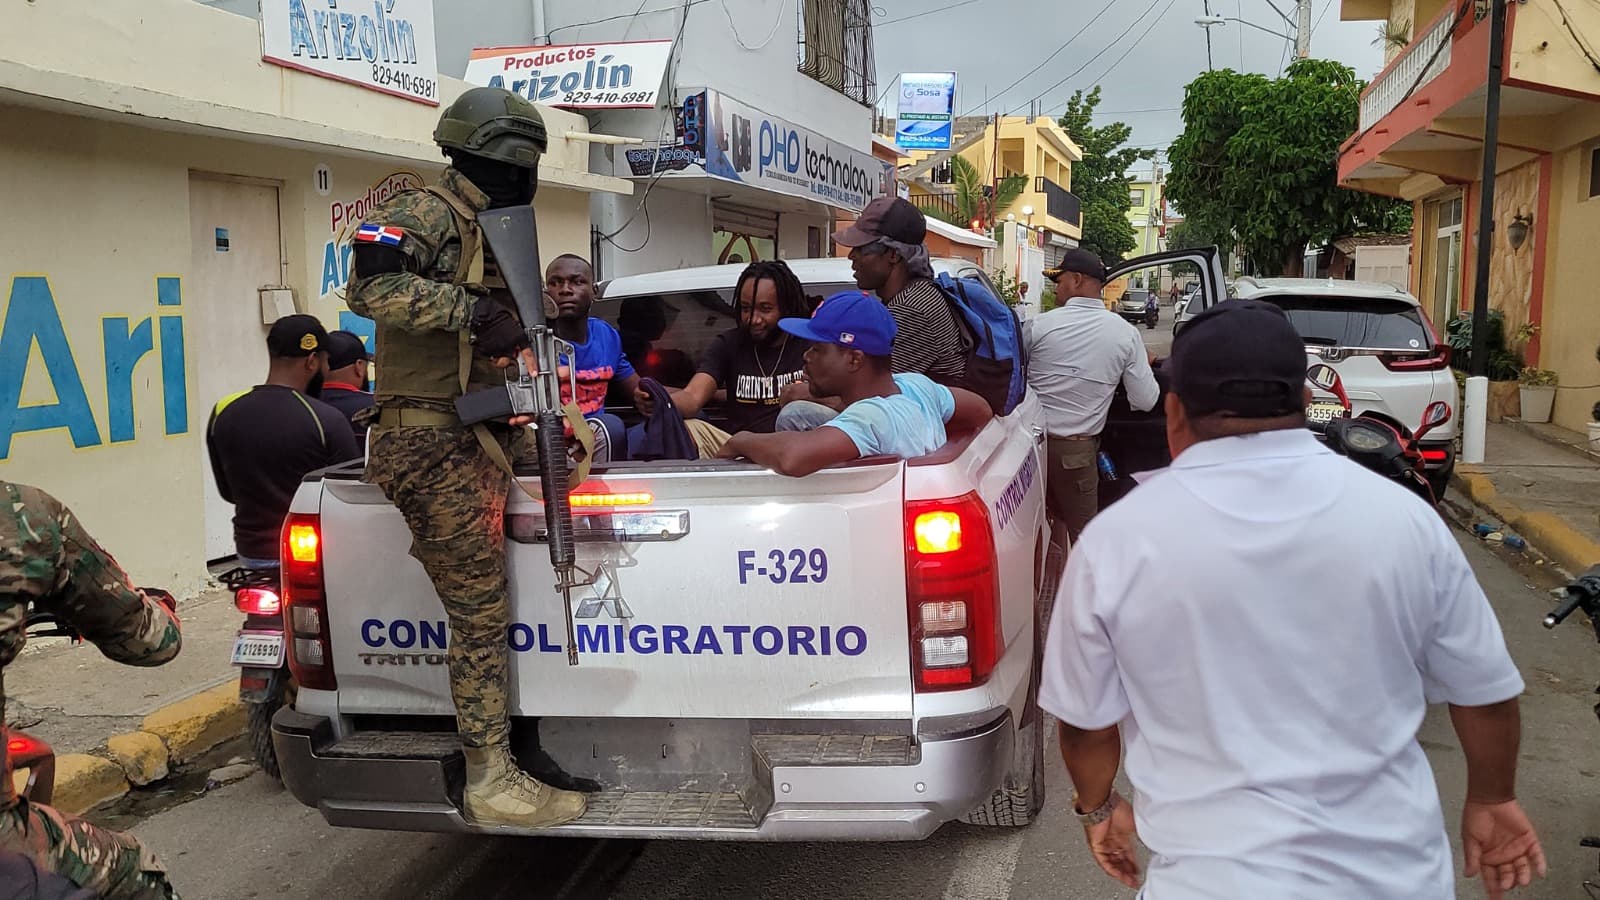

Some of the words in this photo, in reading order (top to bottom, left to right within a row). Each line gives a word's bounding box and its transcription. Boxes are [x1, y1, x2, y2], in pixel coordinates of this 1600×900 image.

[289, 0, 417, 64] Arizolín
[504, 47, 596, 71] Productos
[372, 64, 436, 98] 829-410-6981
[916, 88, 941, 97] Sosa
[563, 91, 654, 104] 829-410-6981
[759, 119, 800, 178] PHD
[805, 135, 873, 206] technology
[317, 169, 328, 190] 11
[738, 548, 828, 584] F-329
[361, 618, 562, 653] CONOL
[577, 624, 867, 656] MIGRATORIO
[358, 653, 450, 665] TRITO
